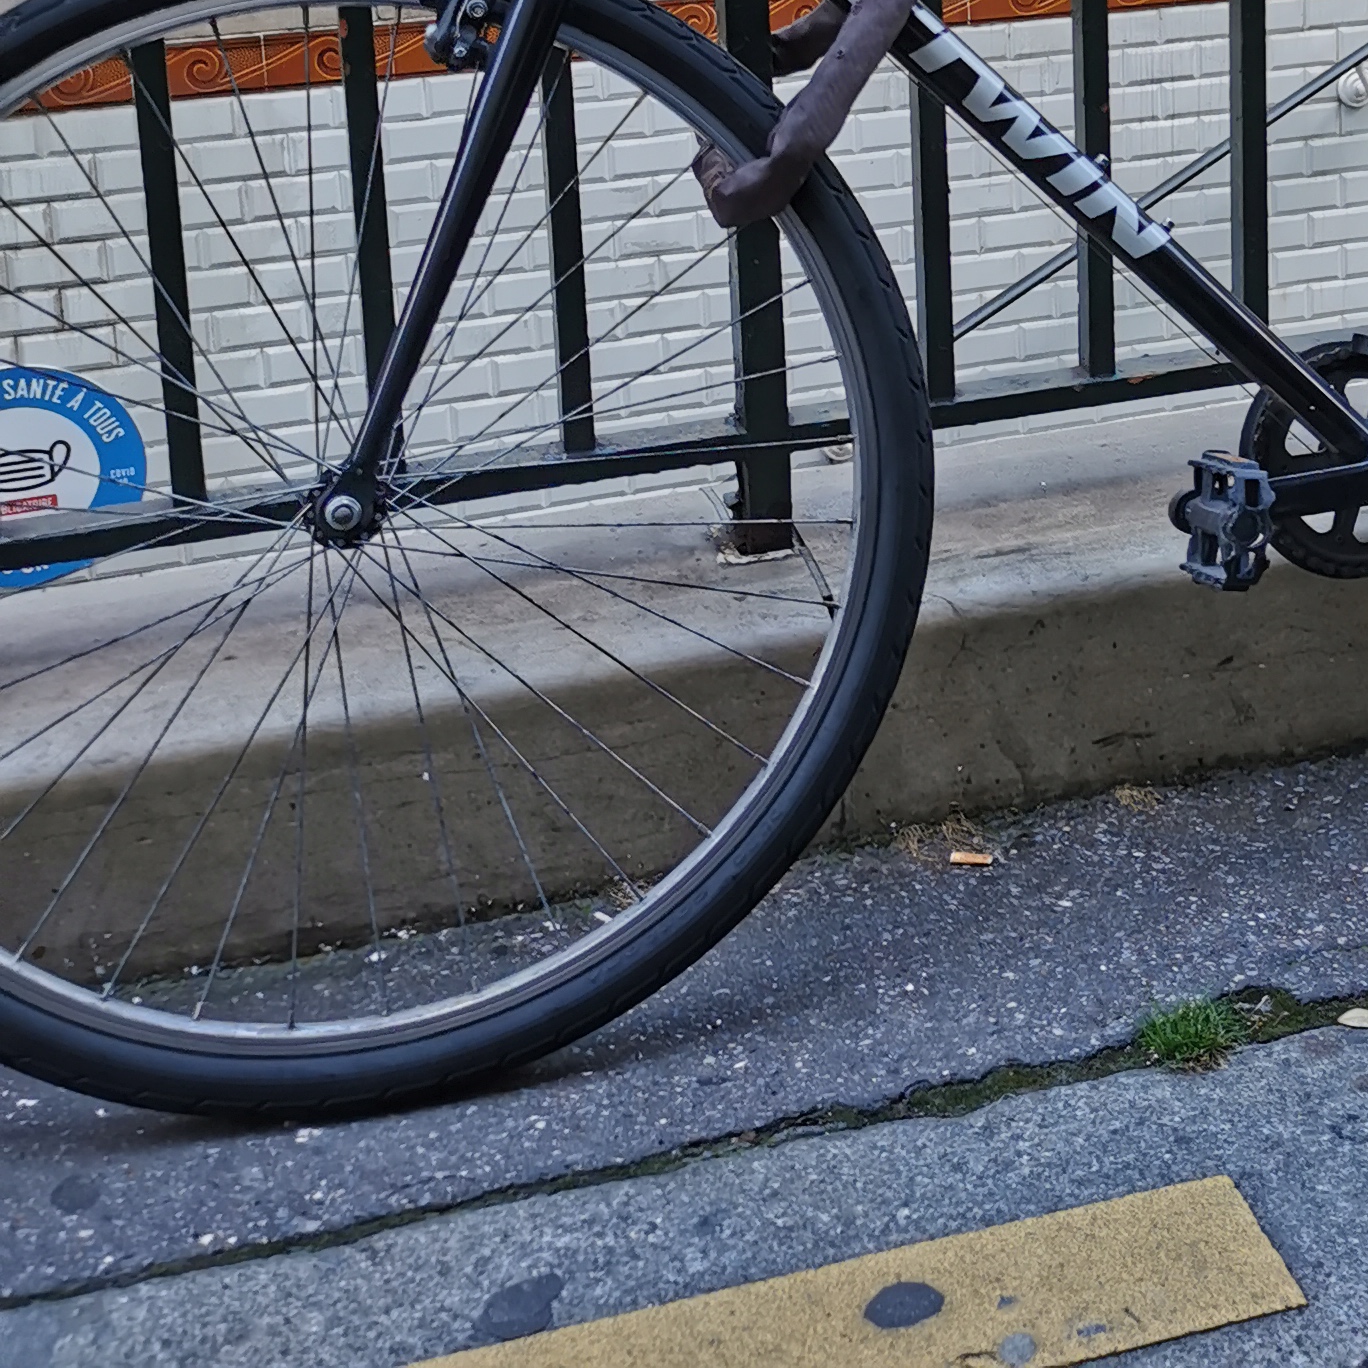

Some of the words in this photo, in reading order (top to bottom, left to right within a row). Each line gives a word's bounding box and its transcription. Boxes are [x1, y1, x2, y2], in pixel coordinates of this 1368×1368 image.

[3, 379, 69, 405] SANTÉ
[66, 388, 85, 412] À
[82, 400, 126, 444] TOUS
[109, 466, 136, 480] COVID
